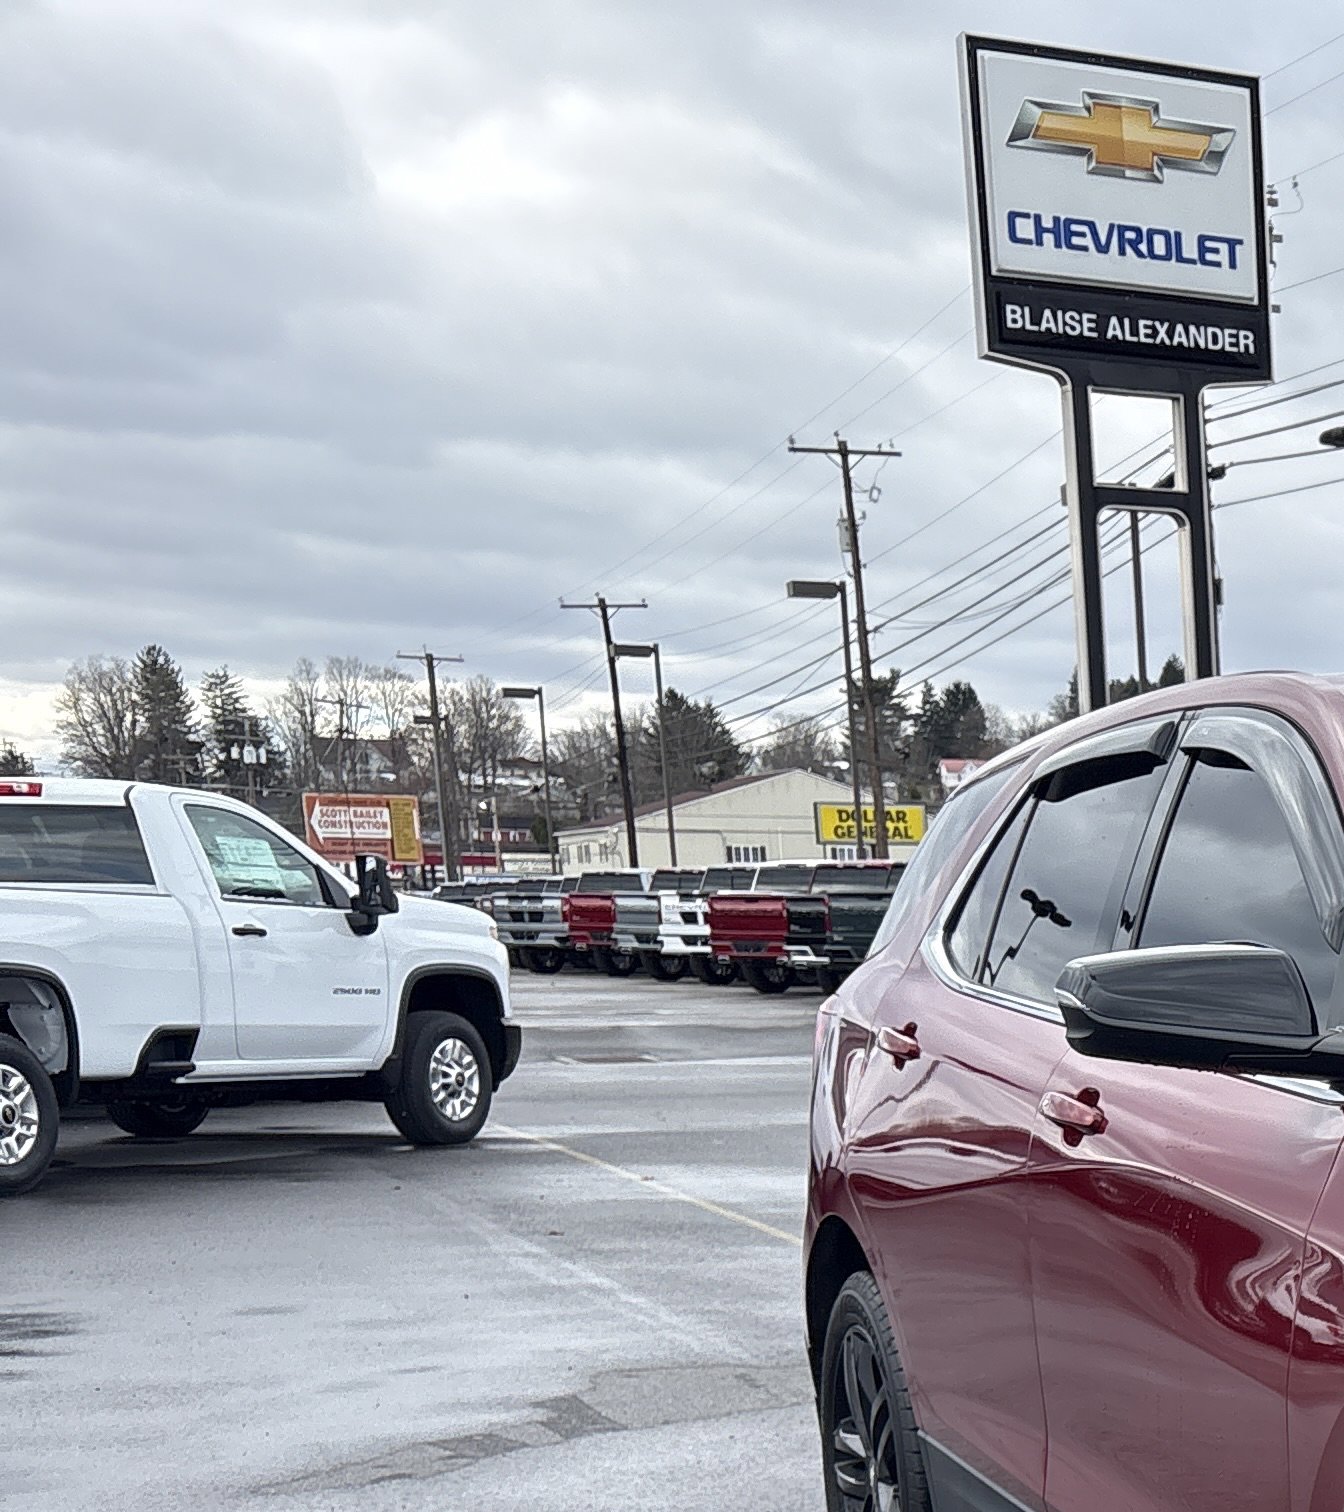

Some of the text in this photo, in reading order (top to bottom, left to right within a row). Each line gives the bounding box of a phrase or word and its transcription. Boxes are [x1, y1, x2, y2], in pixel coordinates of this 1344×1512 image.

[1006, 210, 1244, 271] CHEVROLET
[1005, 304, 1256, 355] BLAISE ALEXANDER
[319, 808, 384, 820] SCOTT BAILEY
[836, 809, 908, 824] DOLAR
[318, 819, 389, 831] CONSTUCTION
[833, 824, 913, 840] GENEAL
